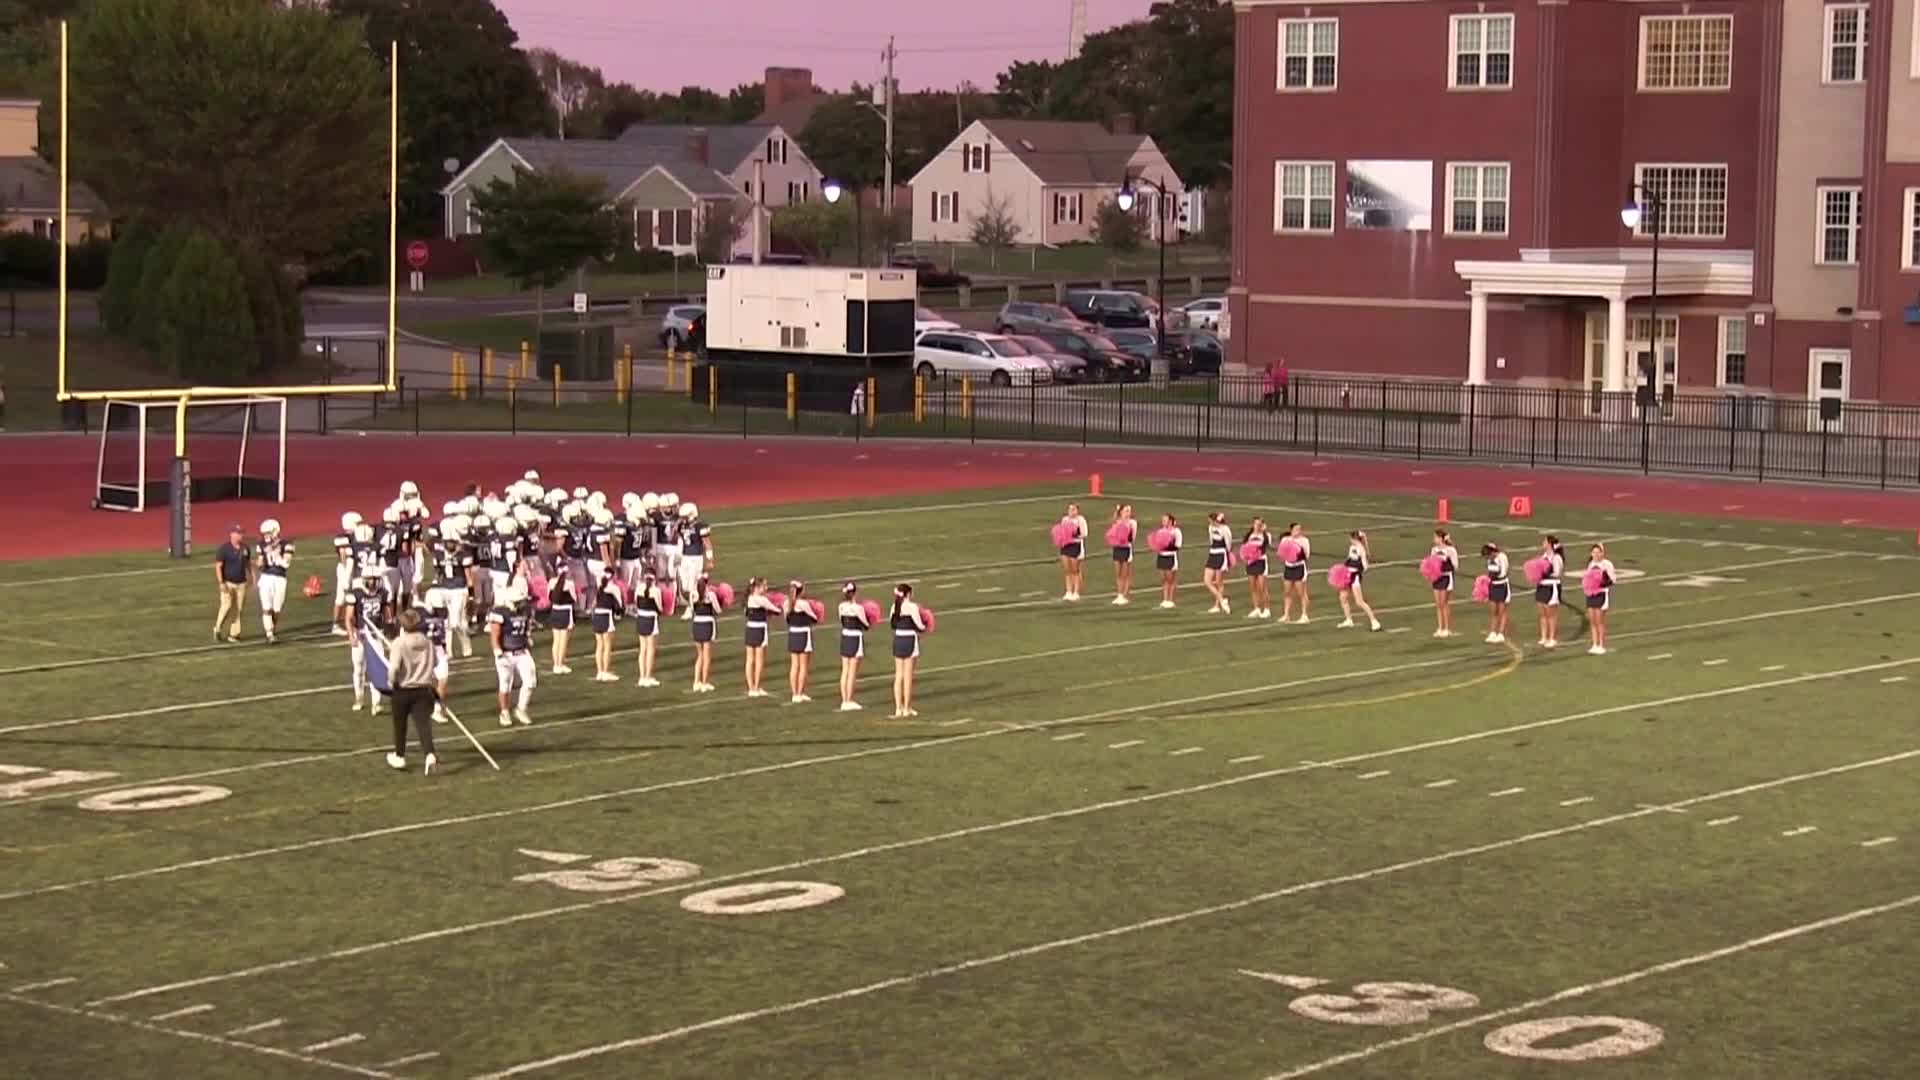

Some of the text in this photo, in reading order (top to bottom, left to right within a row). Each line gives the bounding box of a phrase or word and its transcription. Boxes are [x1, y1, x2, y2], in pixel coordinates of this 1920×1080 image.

[1514, 499, 1523, 512] G
[357, 551, 376, 568] 34
[1288, 981, 1665, 1062] 30
